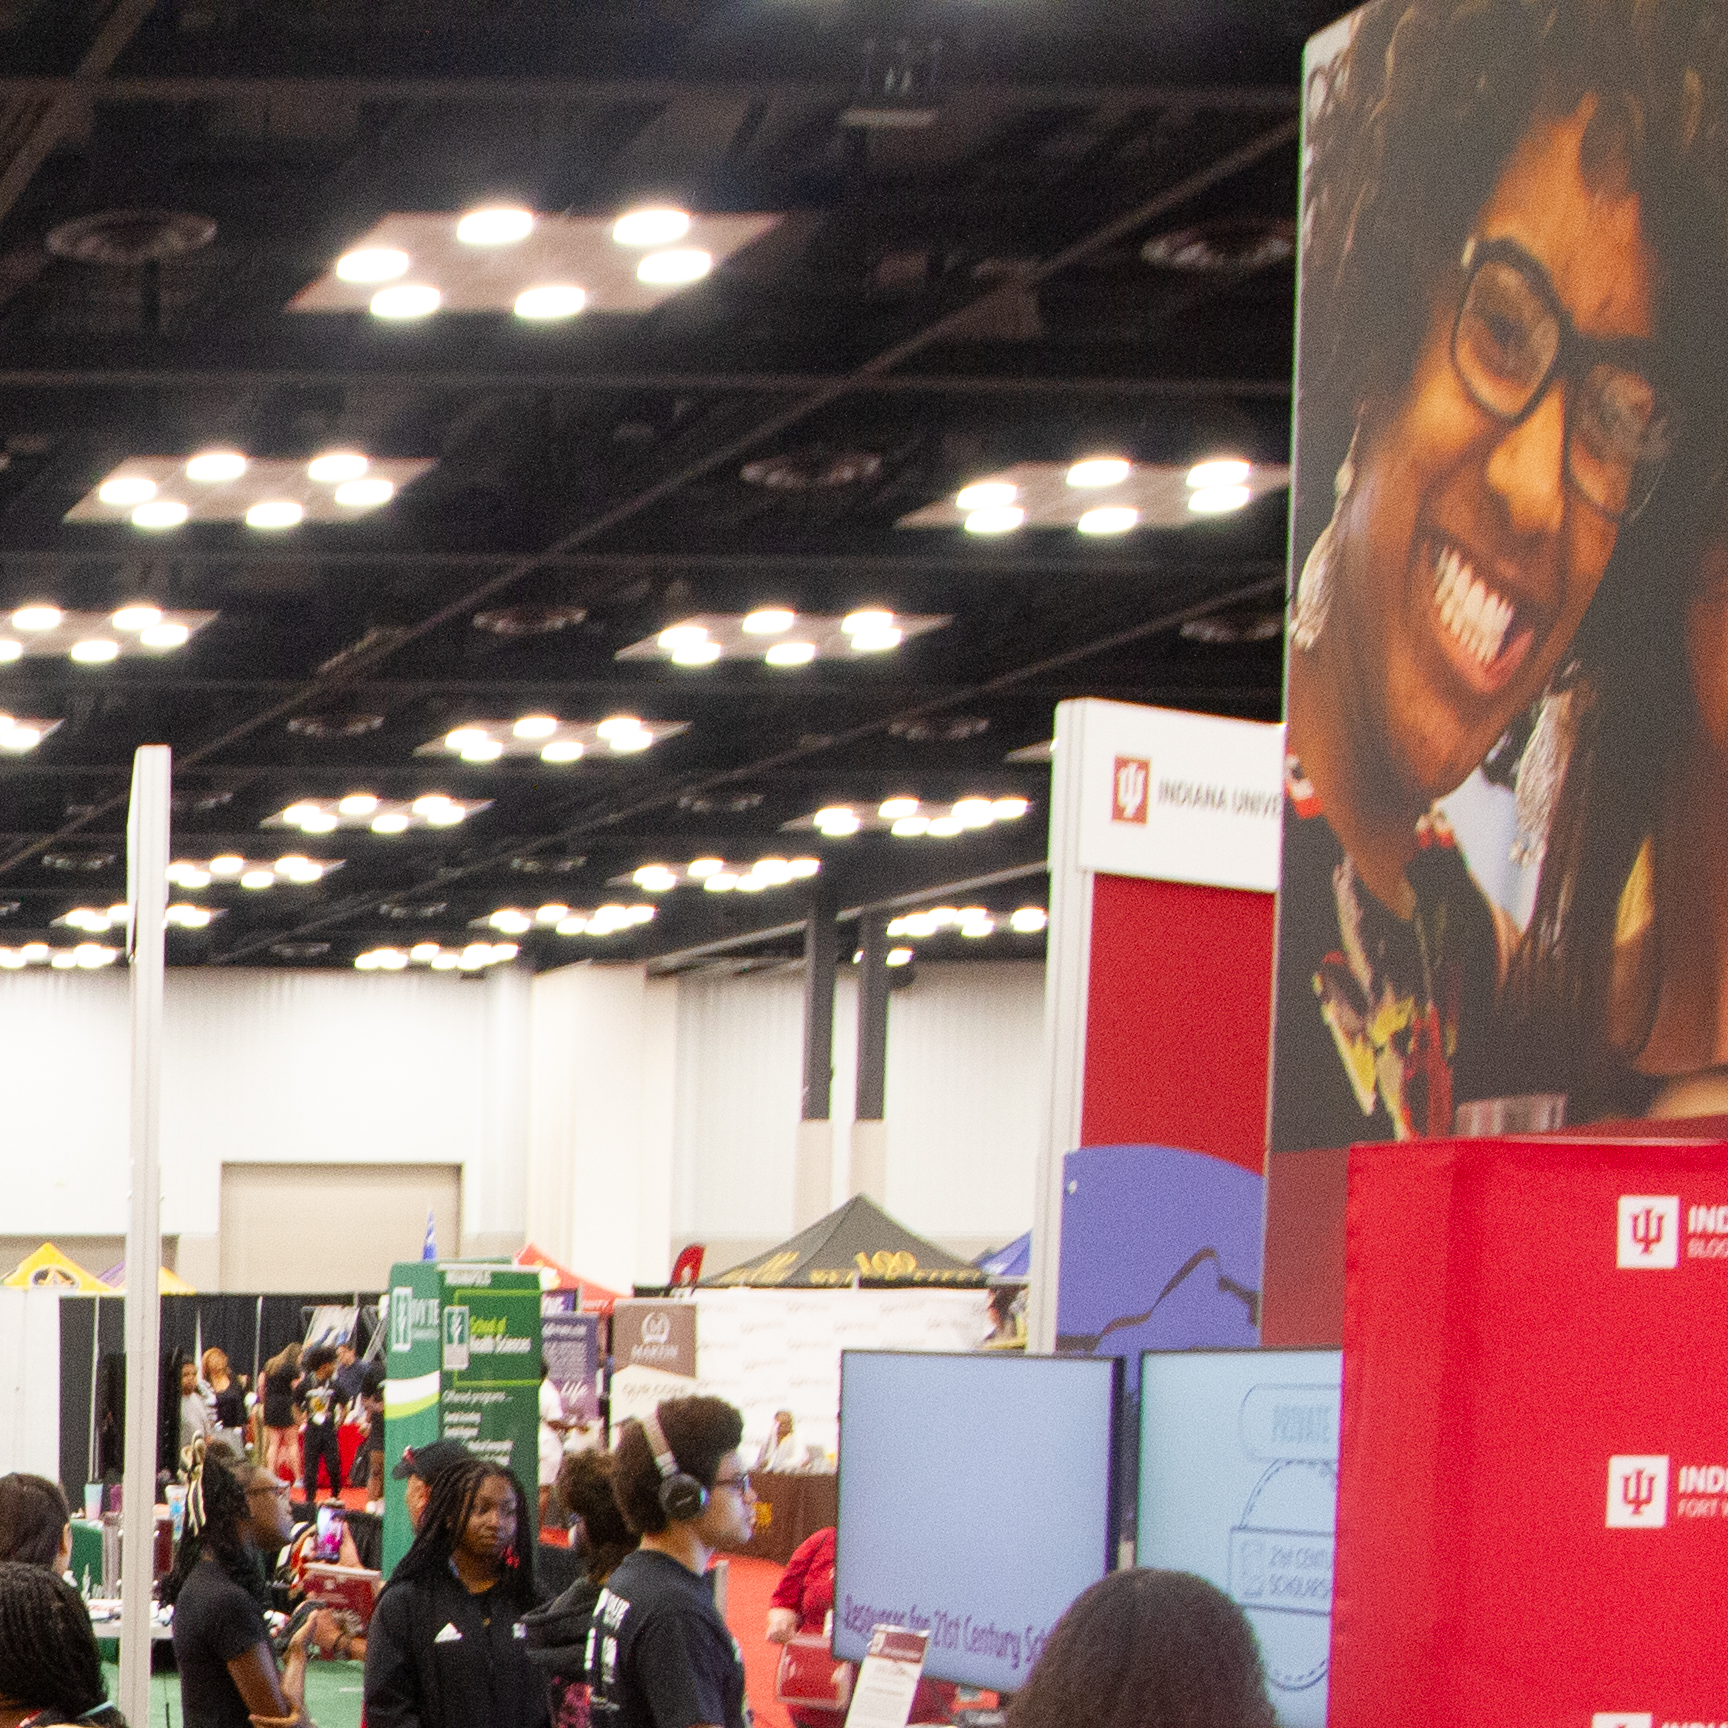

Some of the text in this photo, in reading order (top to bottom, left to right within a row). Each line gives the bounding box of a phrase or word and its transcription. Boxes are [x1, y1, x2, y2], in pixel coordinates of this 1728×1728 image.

[1158, 779, 1282, 819] INDIANA UNIVE
[1687, 1205, 1728, 1234] IND
[1678, 1465, 1728, 1494] INDI
